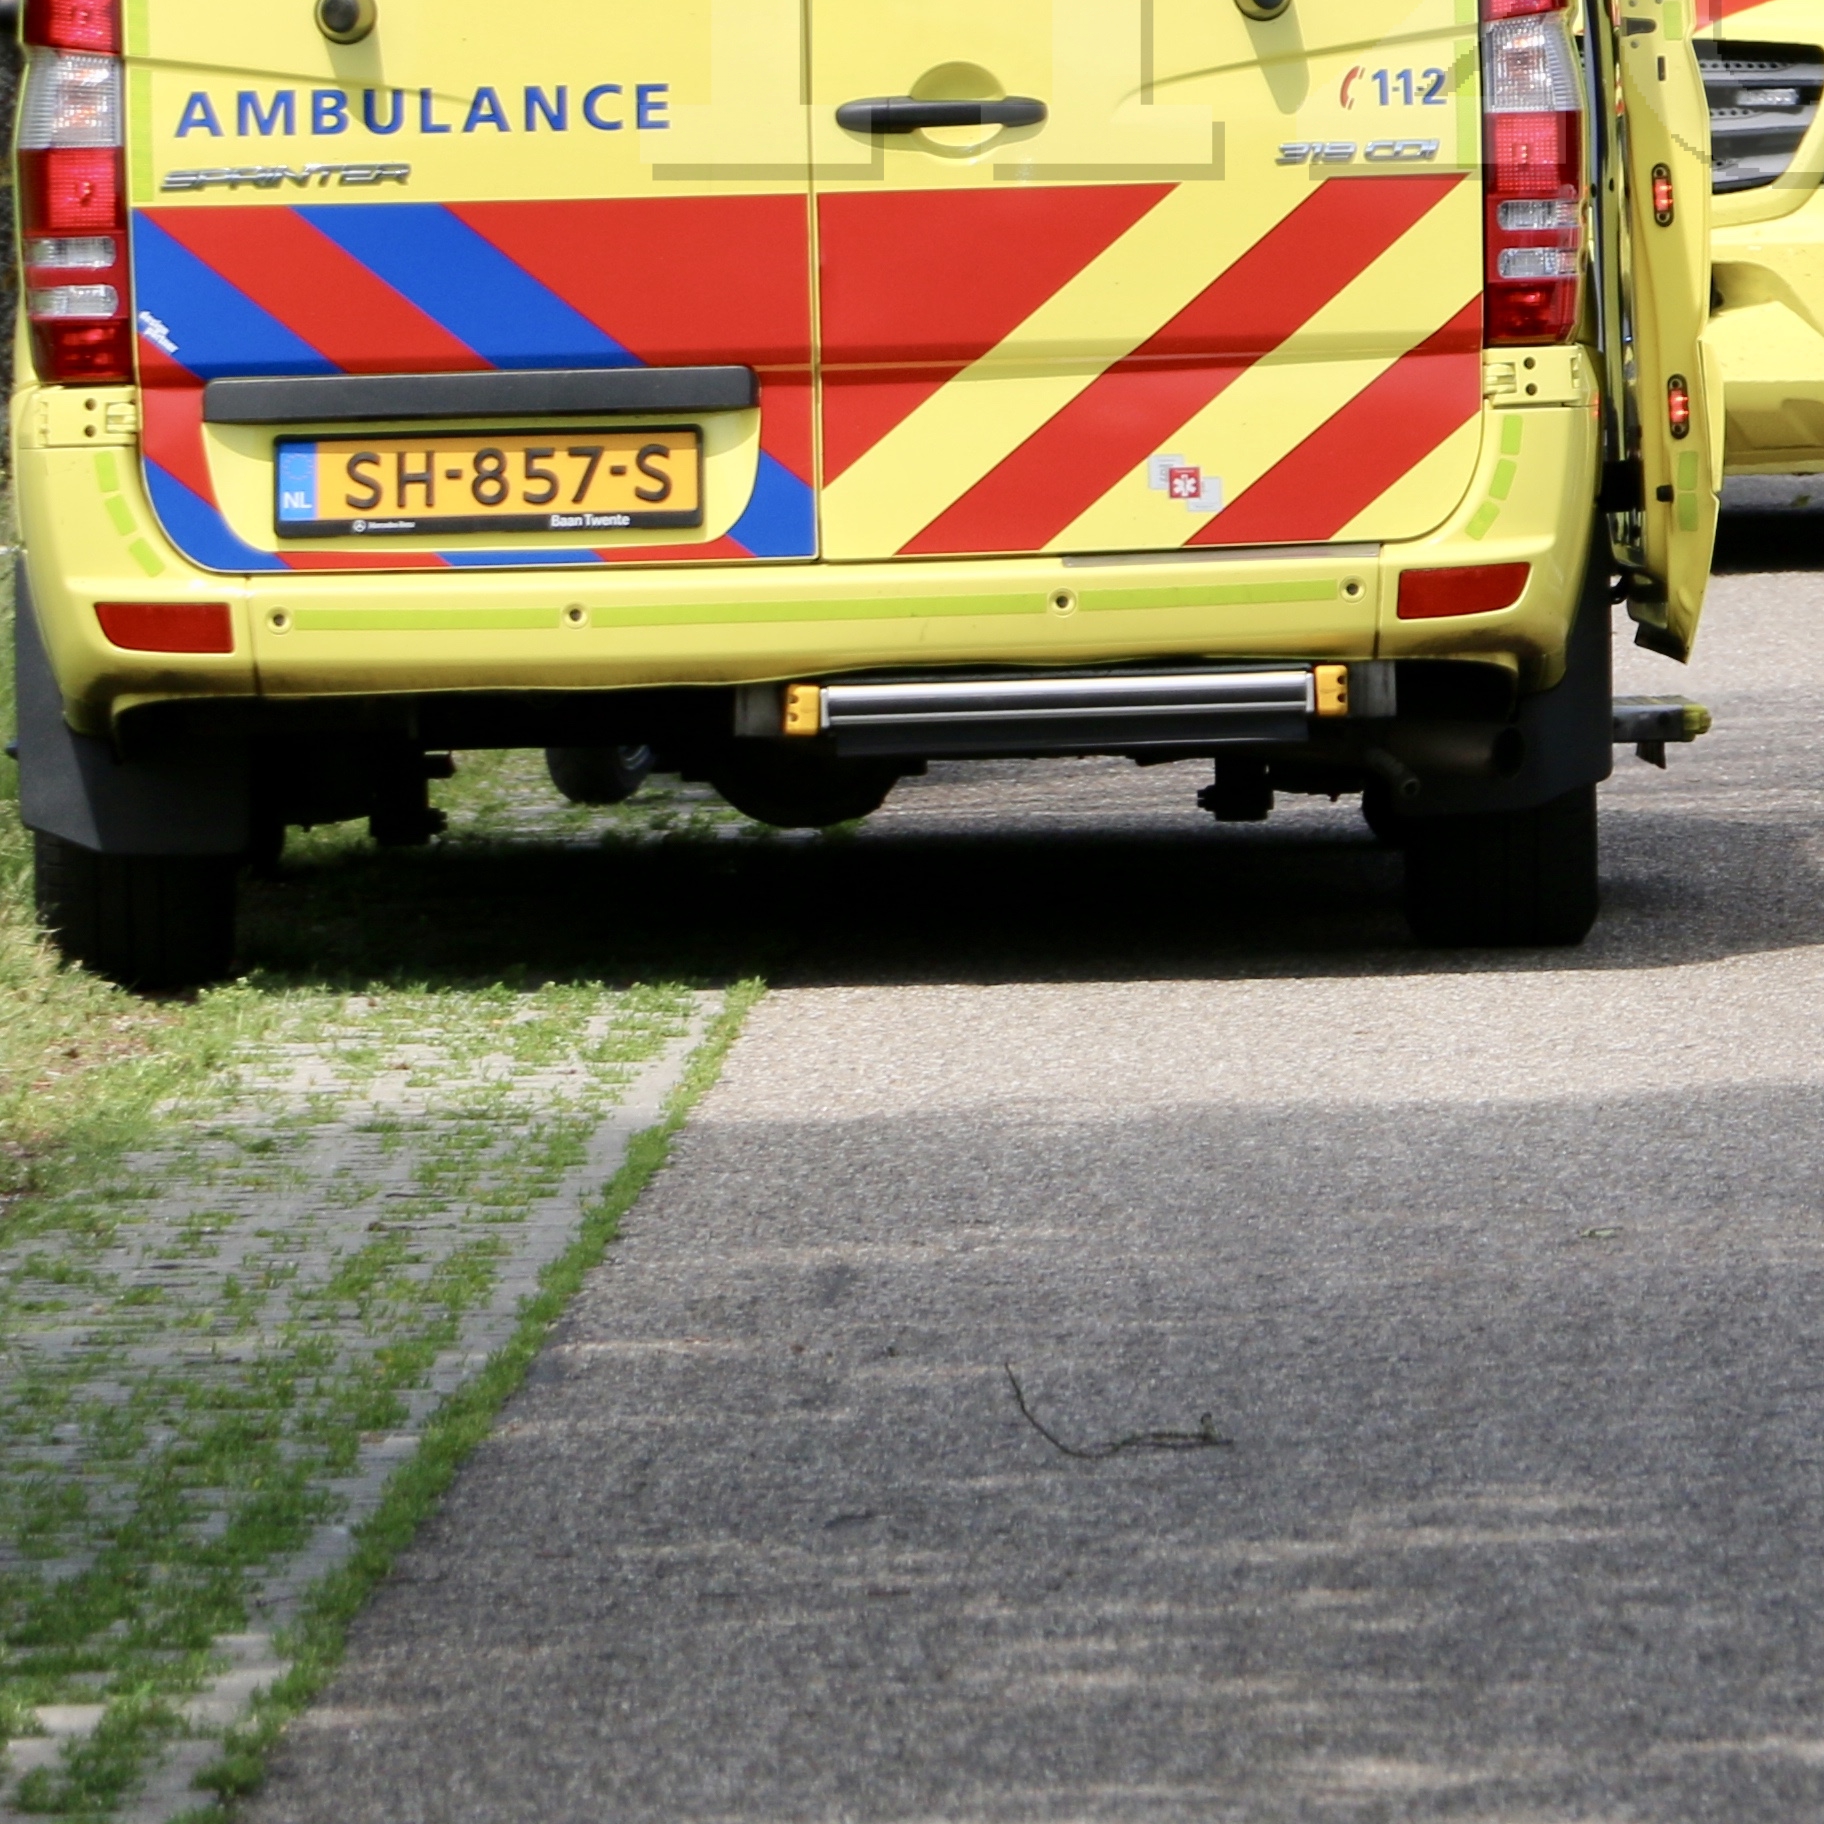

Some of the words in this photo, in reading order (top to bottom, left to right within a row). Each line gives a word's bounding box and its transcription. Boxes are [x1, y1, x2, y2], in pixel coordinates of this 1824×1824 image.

[174, 82, 671, 138] AMBULANCE
[1275, 141, 1357, 166] 319
[1364, 138, 1441, 162] CDI
[159, 161, 412, 193] SPRINTER
[283, 491, 312, 509] NL
[344, 443, 673, 510] SH-857-S
[550, 514, 583, 527] Baan
[583, 513, 631, 527] Twente
